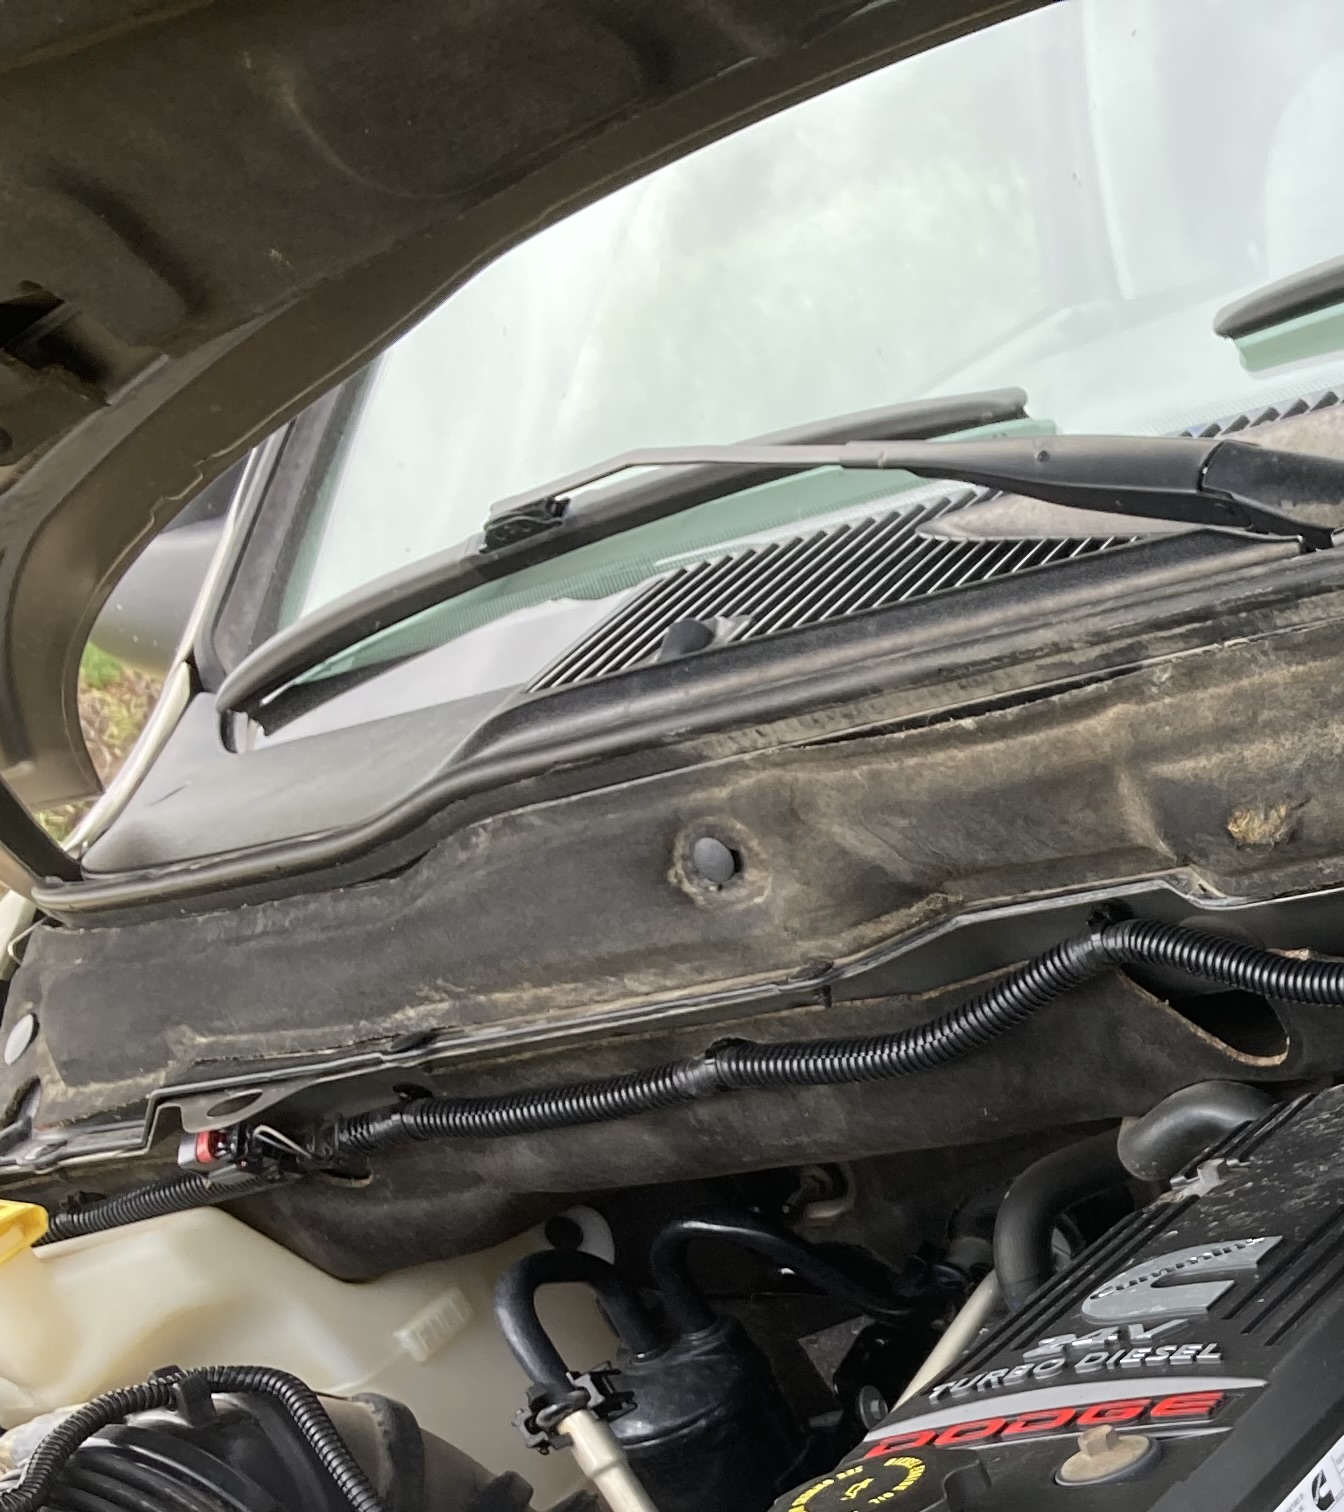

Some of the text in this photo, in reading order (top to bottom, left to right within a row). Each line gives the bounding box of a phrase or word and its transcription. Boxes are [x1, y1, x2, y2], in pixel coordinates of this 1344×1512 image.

[928, 1343, 1222, 1405] TURBO DIESEL
[864, 1391, 1224, 1459] DODGE
